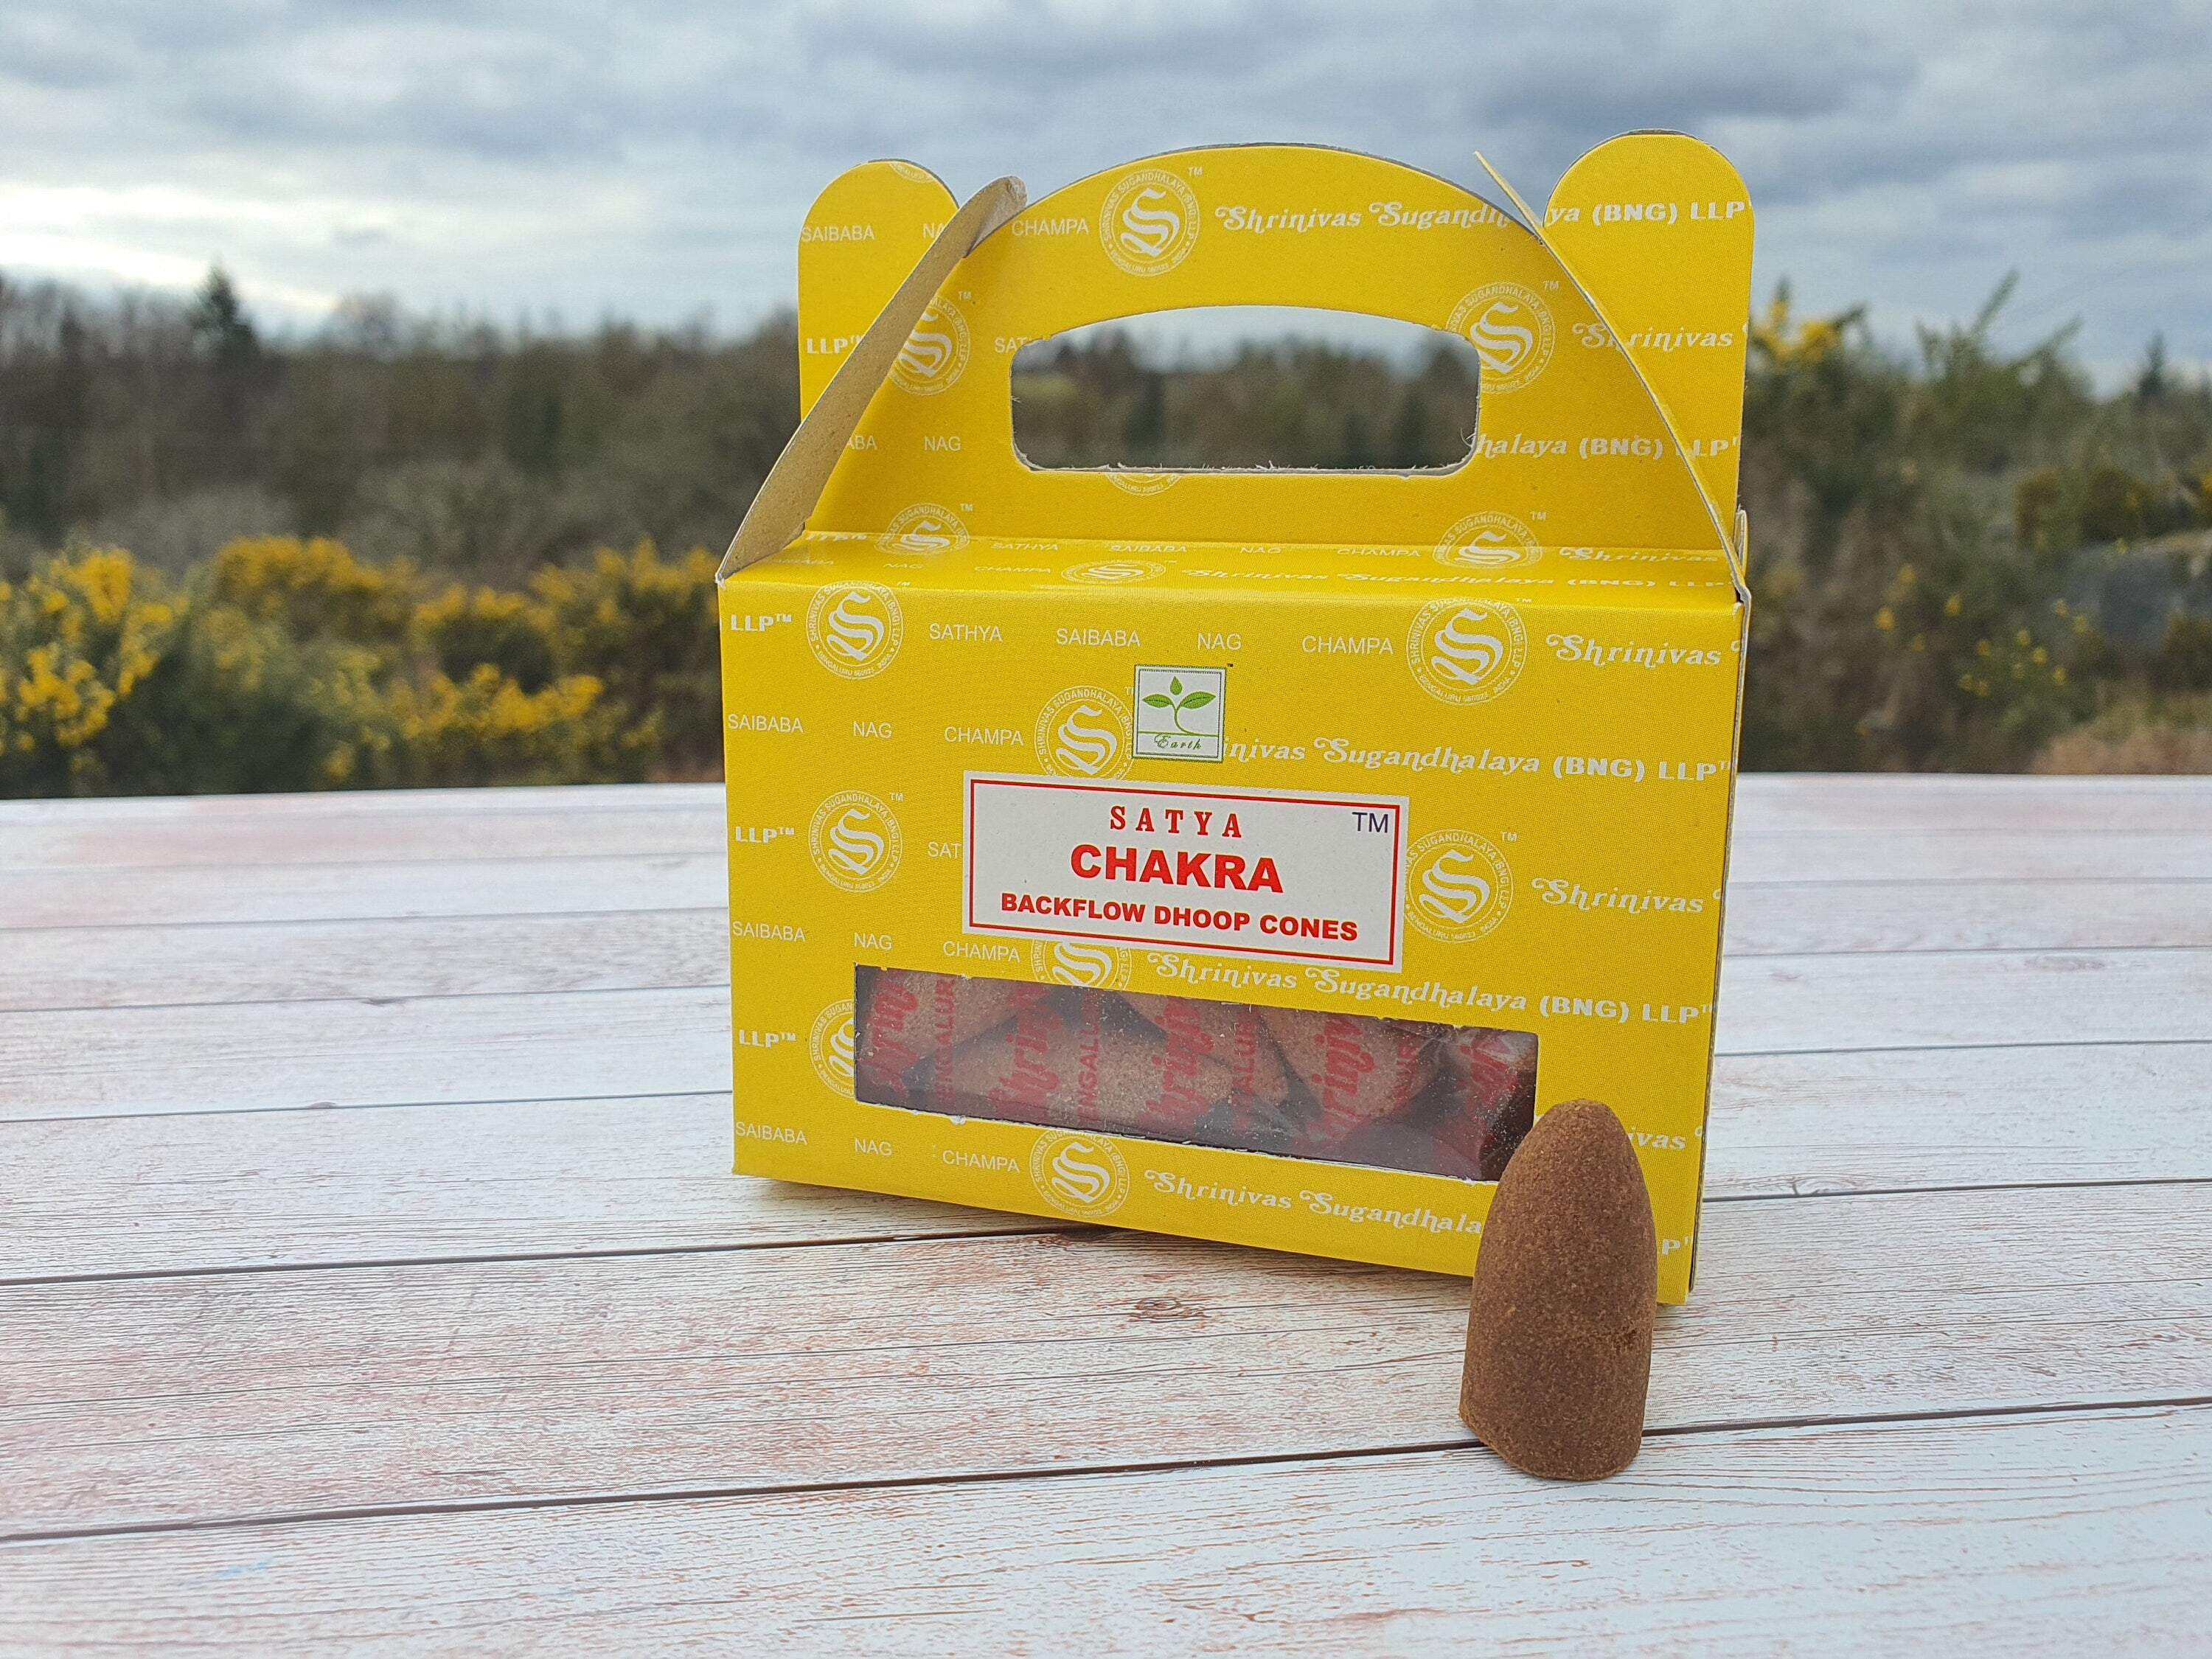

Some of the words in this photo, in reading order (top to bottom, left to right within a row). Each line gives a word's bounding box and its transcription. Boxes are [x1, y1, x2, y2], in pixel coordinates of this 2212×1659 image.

[1012, 218, 1089, 236] CHAMPA
[1214, 206, 1362, 234] Shrinivas
[1592, 203, 1677, 226] (BNG)
[801, 225, 875, 242] SAIBABA
[923, 223, 945, 238] NA
[924, 436, 961, 451] NAG
[1579, 437, 1663, 459] (BNG)
[1336, 548, 1421, 558] CHAMPA
[1559, 546, 1718, 563] Shrinivas
[928, 622, 1004, 644] SATHYA
[1055, 627, 1141, 648] SAIBABA
[1197, 633, 1242, 650] NAG
[1301, 635, 1394, 655] CHAMPA
[1545, 633, 1722, 669] Shrinivas
[727, 714, 804, 734] SAIBABA
[852, 720, 893, 738] NAG
[944, 726, 1024, 747] CHAMPA
[1312, 737, 1541, 776] Sugandhalaya
[1554, 754, 1646, 782] (BNG)
[1154, 734, 1202, 750] Earth
[1110, 805, 1242, 838] SATYA
[1352, 812, 1389, 833] TM
[1071, 844, 1284, 893] CHAKRA
[1531, 877, 1703, 914] Shrinivas
[1001, 893, 1145, 922] BACKFLOW
[1155, 906, 1250, 931] DHOOP
[1260, 914, 1357, 941] CONES
[732, 921, 806, 942] SAIBABA
[854, 933, 893, 950] NAG
[942, 942, 1020, 963] CHAMPA
[1147, 952, 1298, 989] Shrinivas
[1304, 967, 1527, 1010] Sugandhalaya
[1540, 995, 1630, 1023] (BNG)
[735, 1121, 807, 1144] SAIBABA
[854, 1138, 892, 1156] NAG
[942, 1150, 1020, 1172] CHAMPA
[1144, 1169, 1292, 1209] Shrinivas
